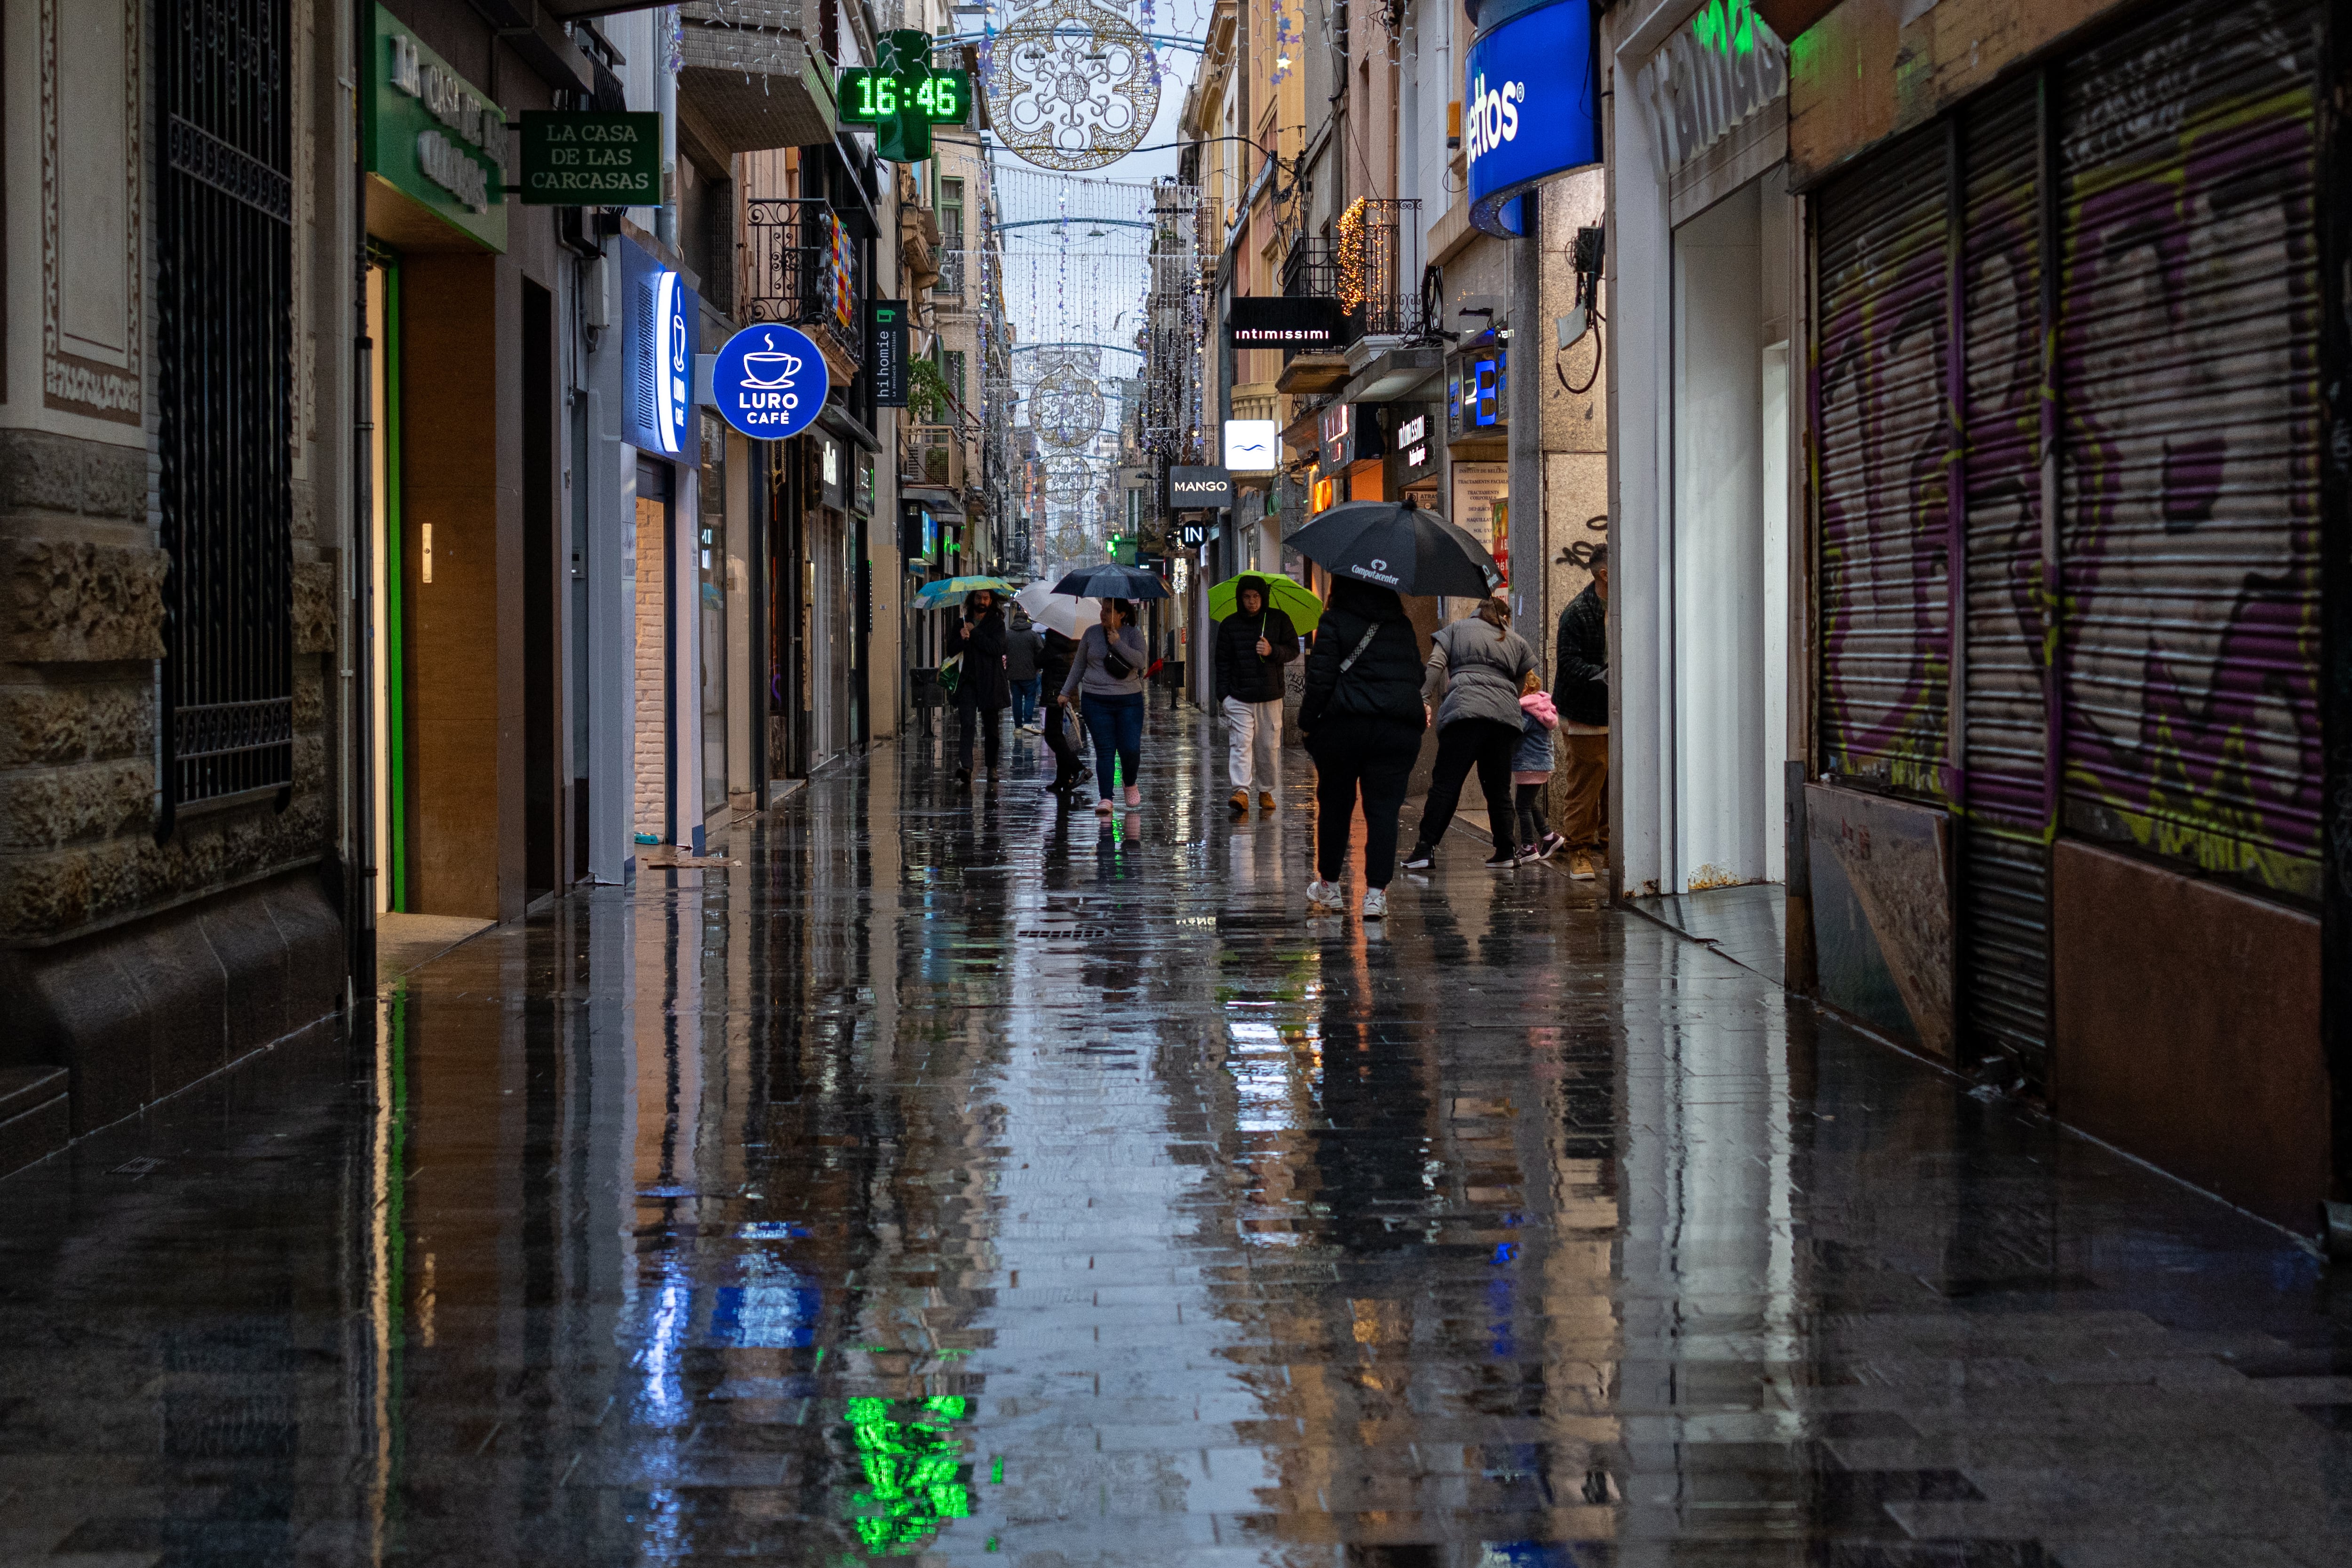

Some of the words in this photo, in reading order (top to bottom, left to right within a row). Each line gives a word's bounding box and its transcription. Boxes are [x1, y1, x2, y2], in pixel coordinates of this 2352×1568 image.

[857, 77, 956, 116] 16:46
[546, 125, 576, 142] LA
[581, 125, 638, 143] CASA
[551, 149, 580, 165] DE
[588, 149, 632, 165] LAS
[532, 172, 649, 189] CARCASAS
[1236, 328, 1329, 340] intimissimi
[877, 331, 889, 375] homie
[877, 382, 889, 397] hi
[739, 393, 799, 409] LURO
[747, 410, 790, 424] CAFÉ
[1174, 481, 1227, 492] MANGO
[1184, 526, 1203, 542] IN
[1351, 565, 1399, 585] Computacenter
